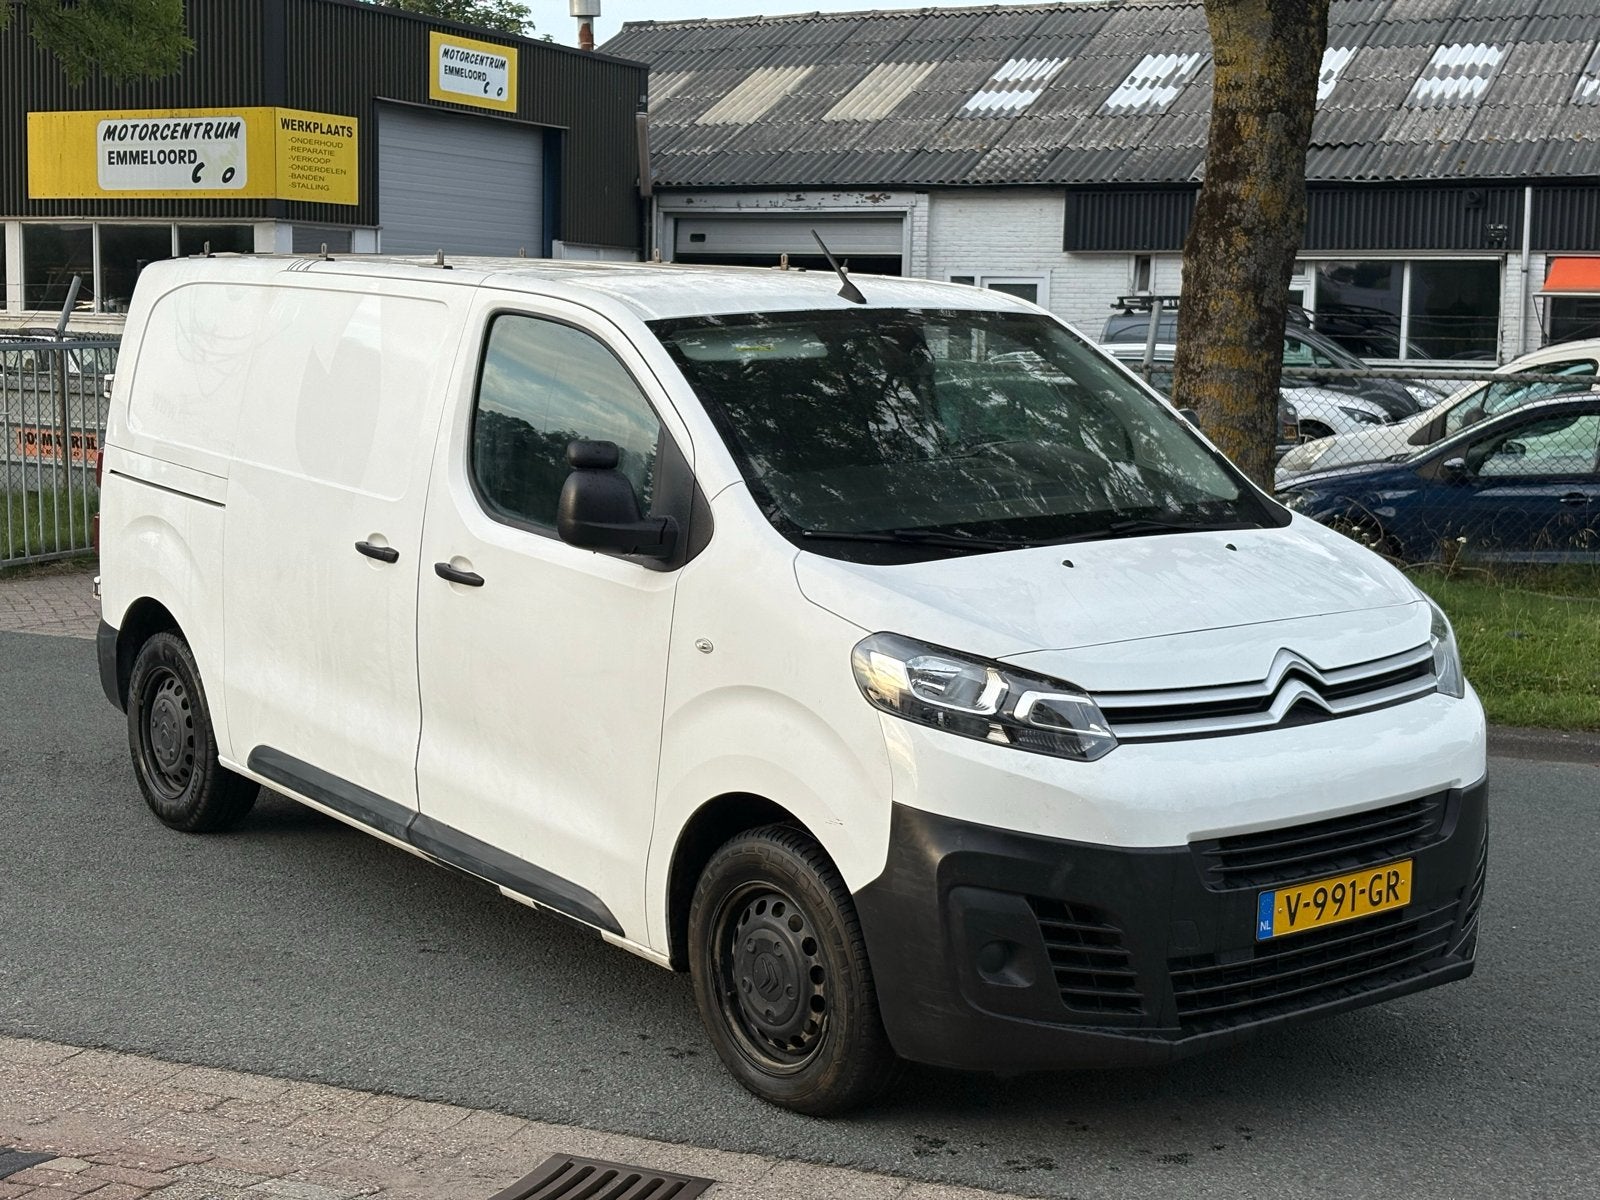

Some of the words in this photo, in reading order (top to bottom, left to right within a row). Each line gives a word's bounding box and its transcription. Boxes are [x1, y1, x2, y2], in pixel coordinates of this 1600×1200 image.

[442, 47, 507, 71] MOTORCENTRUM
[444, 64, 487, 82] EMMELOORD
[102, 121, 241, 141] MOTORCENTRUM
[280, 117, 353, 138] WERKPLAATS
[107, 149, 198, 166] EMMELOORD
[1285, 869, 1400, 926] V-991-GR
[1260, 920, 1271, 931] NL
